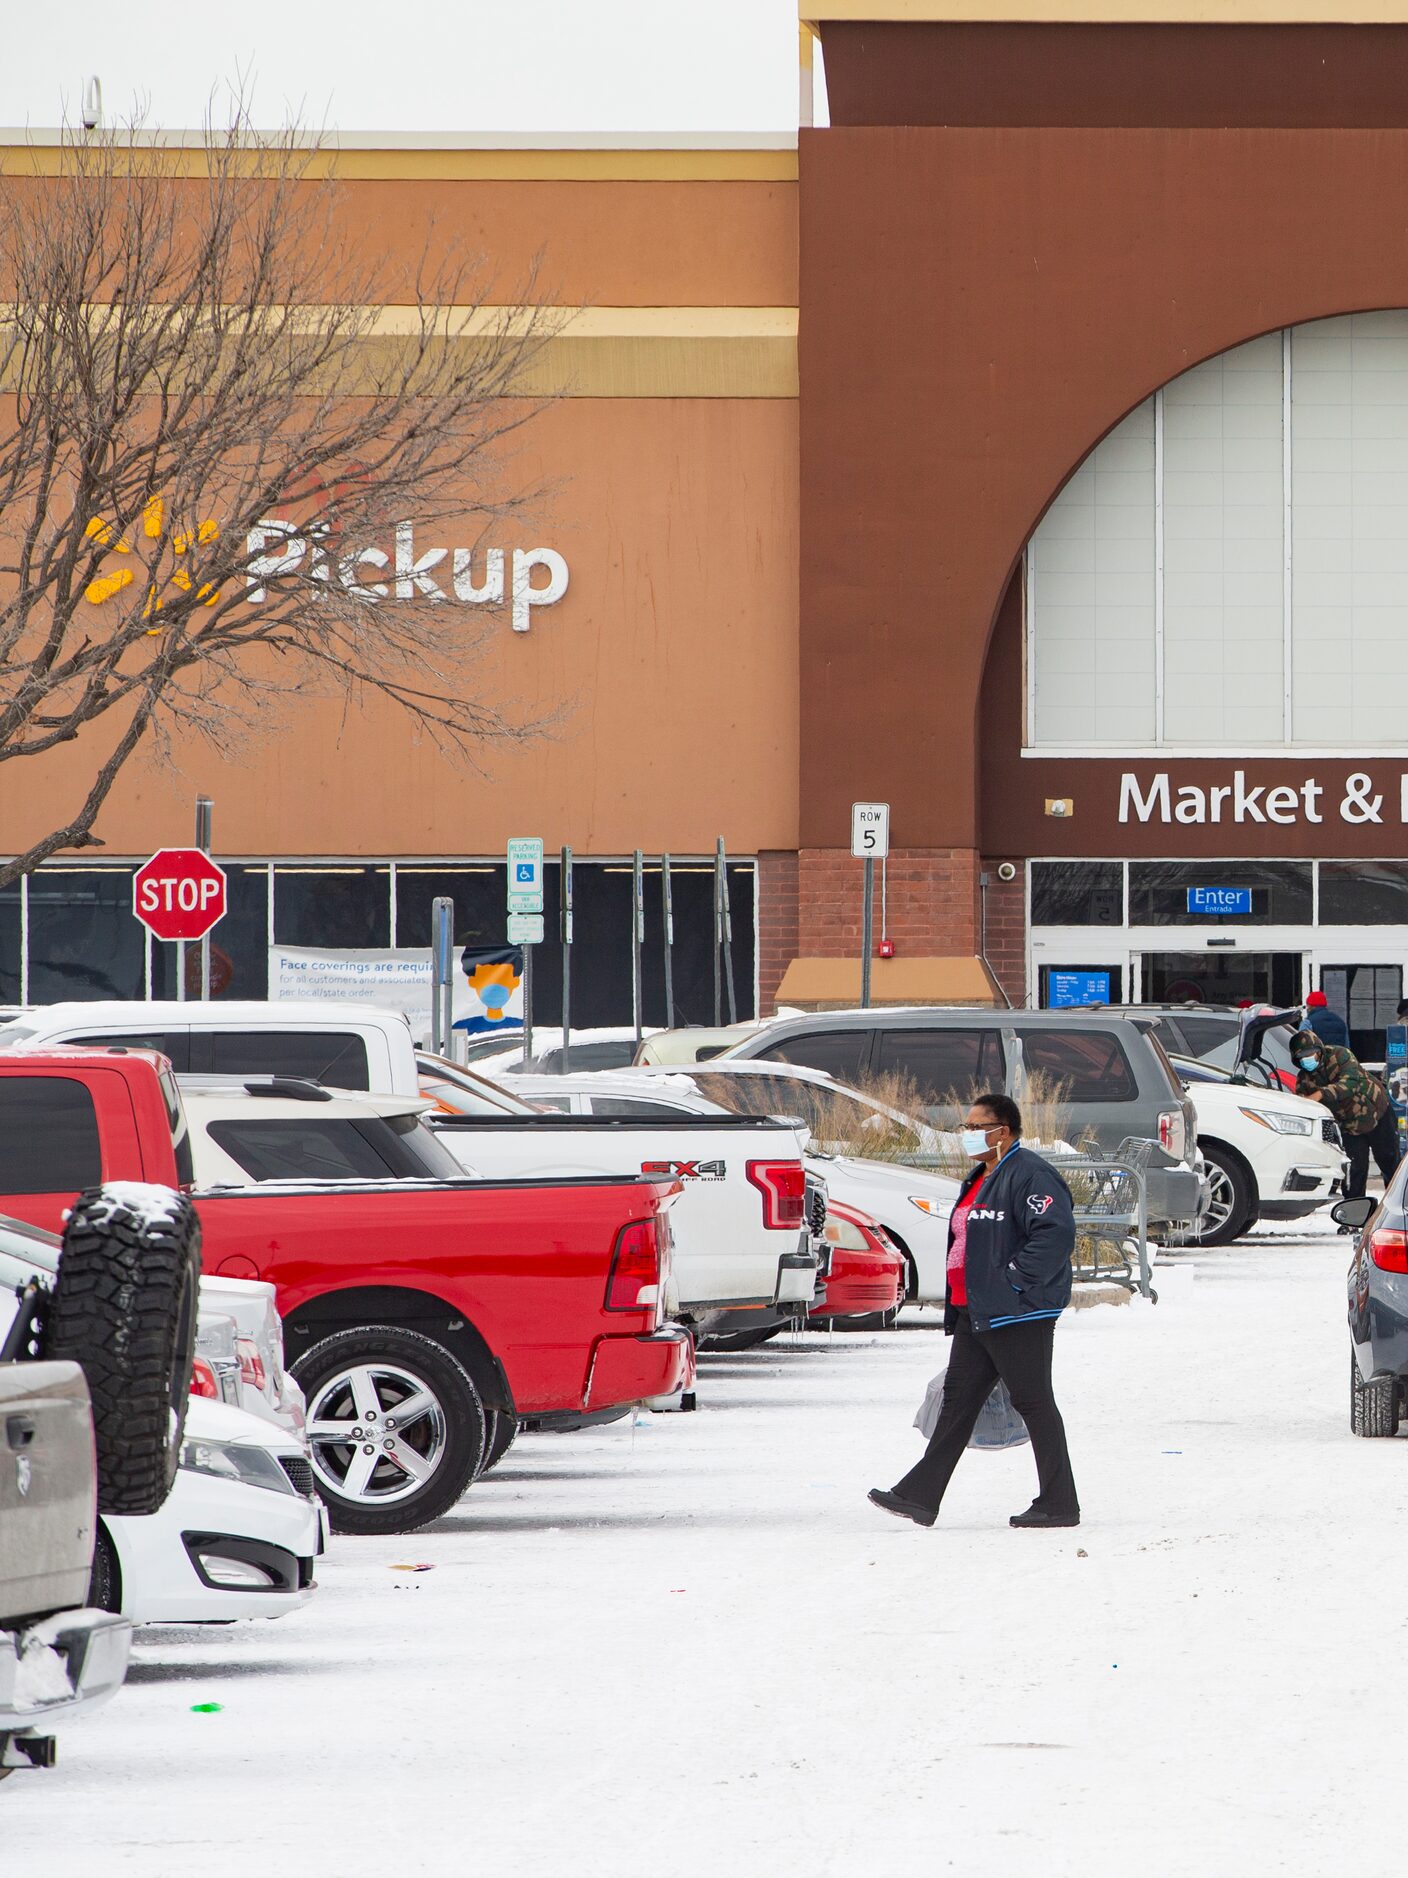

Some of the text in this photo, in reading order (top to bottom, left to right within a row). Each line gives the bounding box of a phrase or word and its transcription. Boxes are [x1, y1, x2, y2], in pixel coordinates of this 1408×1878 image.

[246, 519, 570, 632] Pickup
[1118, 770, 1324, 823] Market
[1340, 772, 1384, 823] &
[860, 811, 882, 822] ROW
[864, 830, 876, 849] 5
[140, 877, 220, 912] STOP
[1195, 887, 1244, 905] Enter
[280, 958, 308, 970] Face
[311, 960, 370, 974] coverings
[375, 963, 393, 972] are
[279, 975, 294, 984] for
[296, 975, 307, 984] all
[308, 976, 357, 985] customers
[359, 976, 376, 985] and
[279, 989, 294, 999] per
[297, 988, 346, 998] local/state
